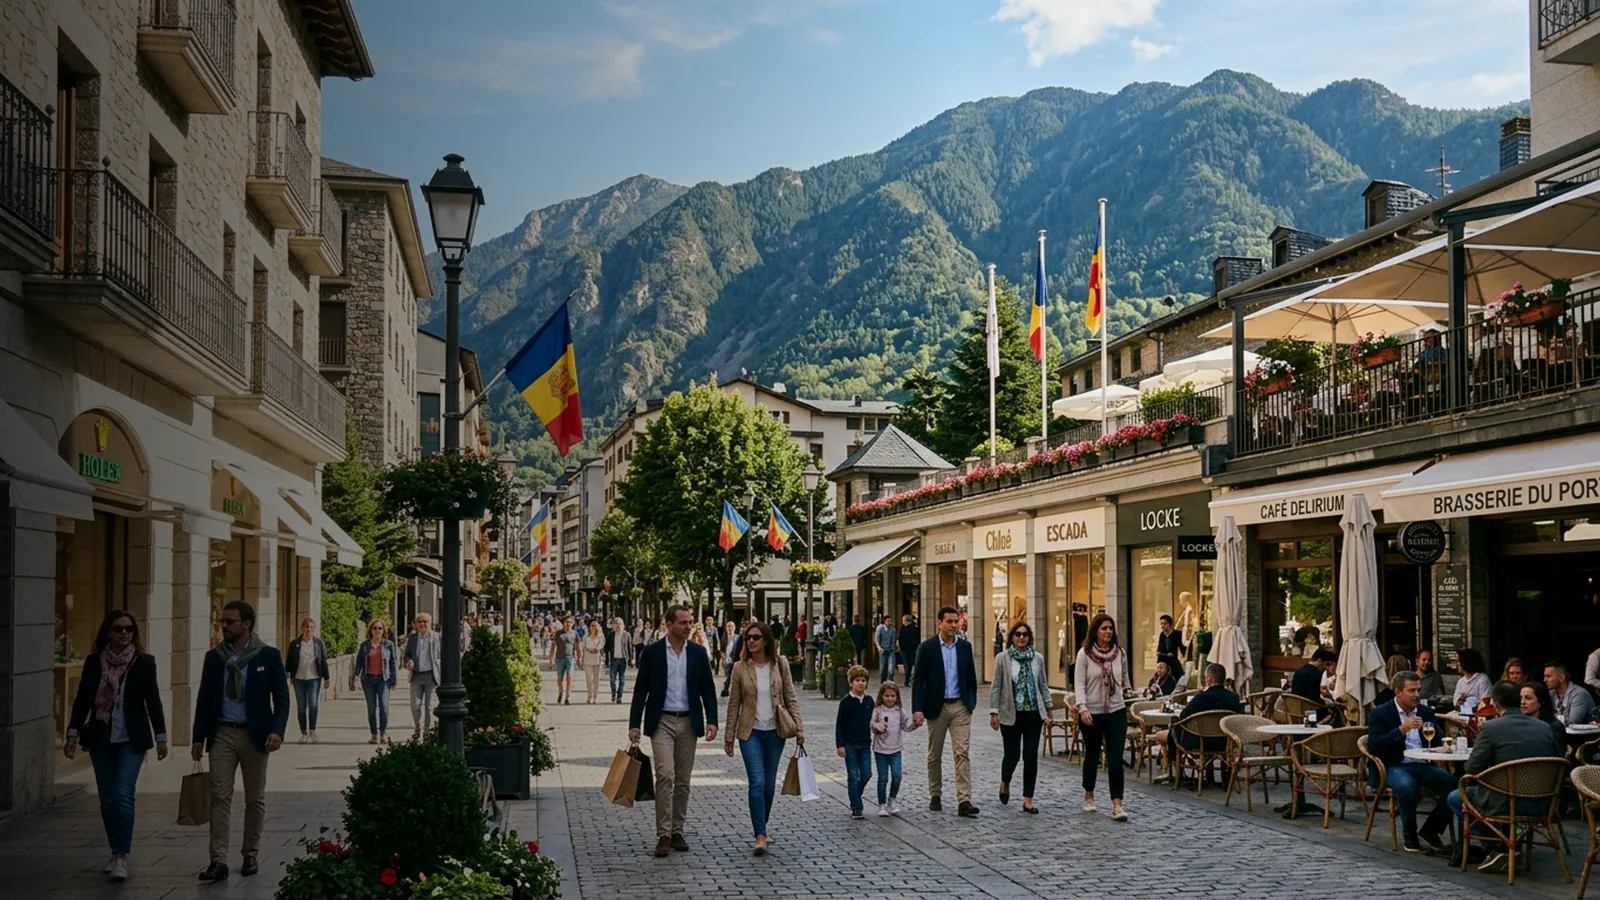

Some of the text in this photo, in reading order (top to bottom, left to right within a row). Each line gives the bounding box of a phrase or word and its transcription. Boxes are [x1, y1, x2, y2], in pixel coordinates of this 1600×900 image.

[1260, 495, 1344, 519] CAFÉ DELIRIUM
[1433, 477, 1600, 514] BRASSERIE DU POR
[1140, 507, 1181, 531] LOCKE
[985, 529, 1012, 552] Chloé
[1046, 521, 1088, 542] ESCADA
[1182, 543, 1215, 553] LOCKE
